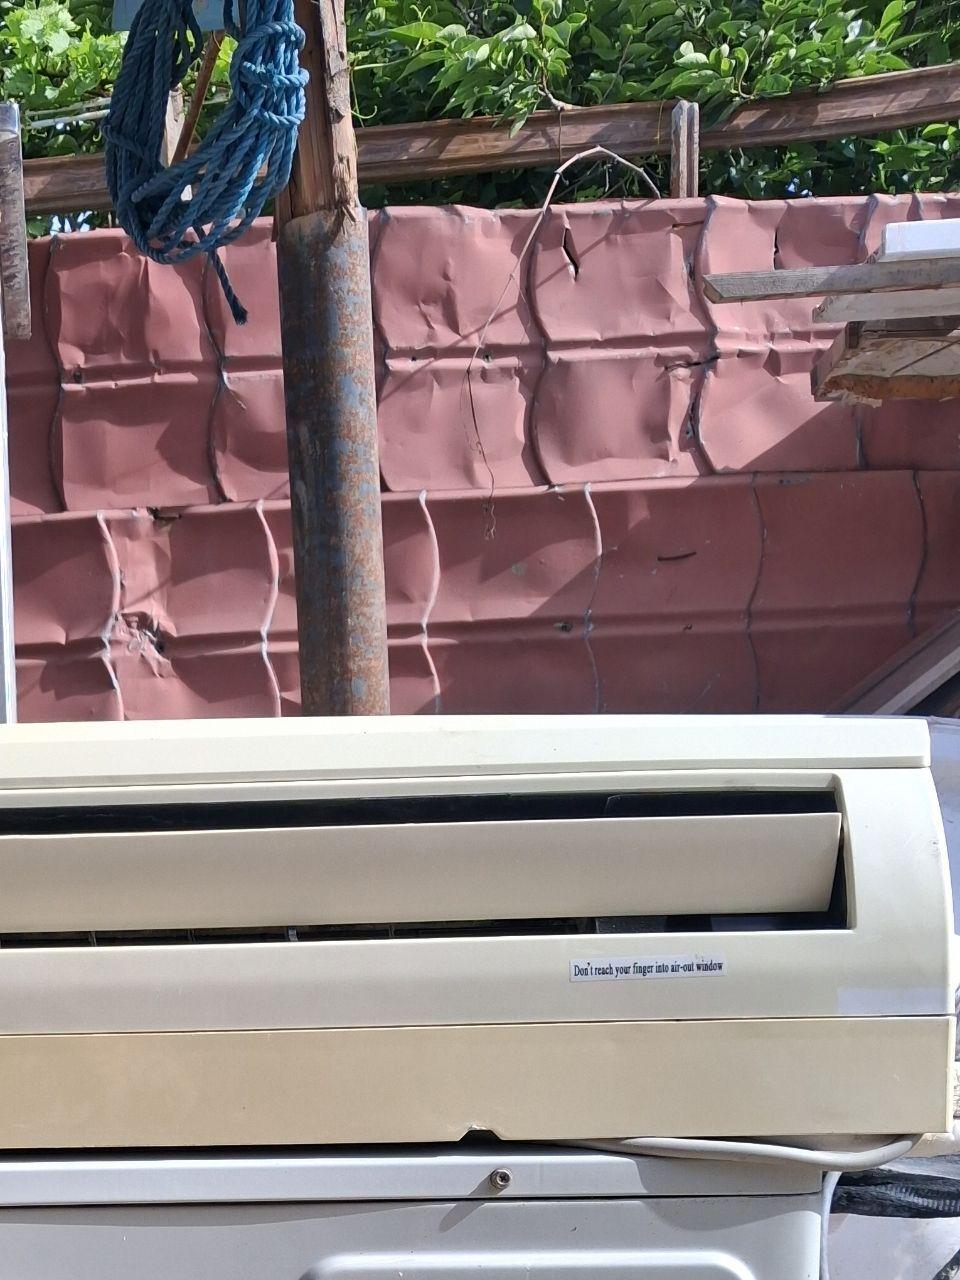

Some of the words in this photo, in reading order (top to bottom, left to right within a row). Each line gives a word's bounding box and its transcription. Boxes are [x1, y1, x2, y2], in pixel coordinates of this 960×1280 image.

[574, 962, 593, 976] Don't
[595, 964, 613, 976] reach
[615, 964, 631, 977] your
[633, 962, 653, 976] finger
[655, 962, 668, 973] into
[671, 961, 694, 972] air-out
[696, 960, 723, 971] window
